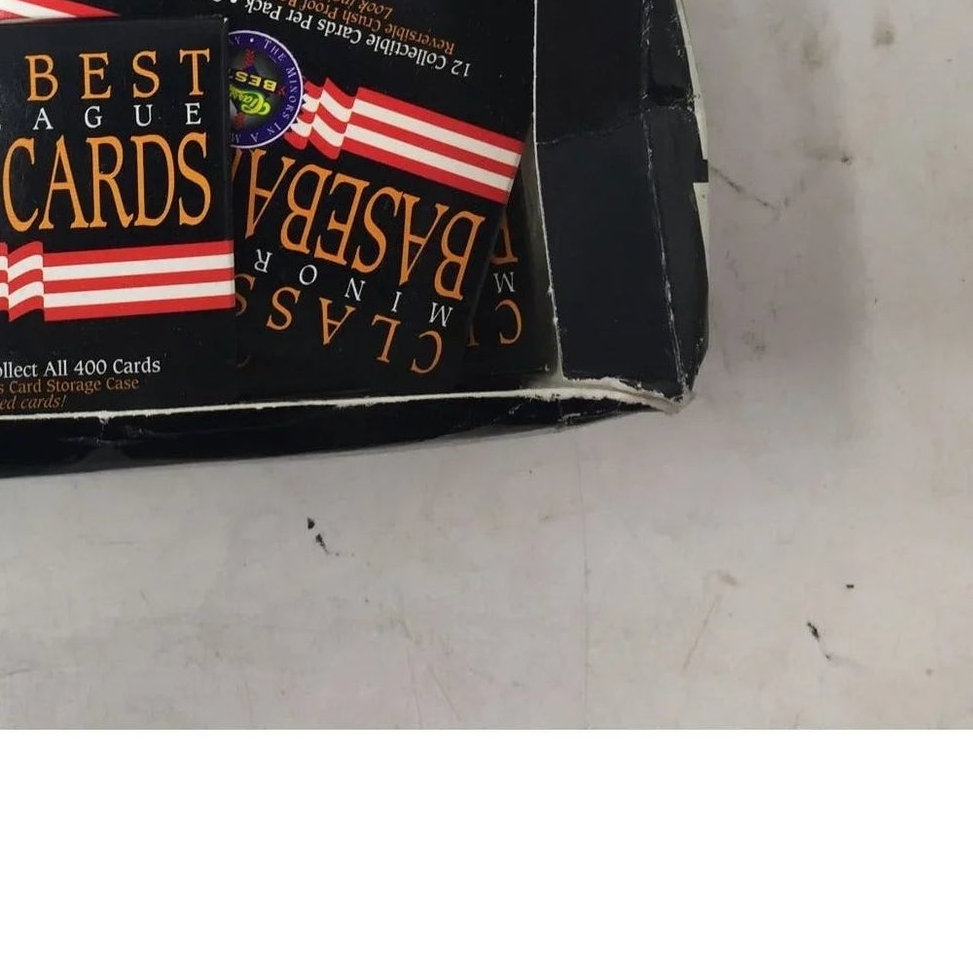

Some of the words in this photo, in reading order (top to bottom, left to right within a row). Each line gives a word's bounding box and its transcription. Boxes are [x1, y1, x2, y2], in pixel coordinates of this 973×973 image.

[285, 8, 313, 31] Per
[342, 9, 382, 28] Crush
[316, 18, 362, 45] Cards
[384, 22, 456, 56] Reversible
[365, 38, 447, 71] Collectible
[25, 48, 210, 102] BEST
[451, 58, 472, 78] 12
[234, 70, 277, 92] BES
[2, 132, 212, 232] CARDS
[231, 148, 485, 300] BASEBA
[253, 248, 453, 327] MINOR
[43, 359, 68, 377] All
[74, 359, 107, 376] 400
[112, 356, 161, 374] Cards
[9, 378, 42, 394] Card
[46, 378, 101, 394] Storage
[105, 377, 139, 391] Case
[20, 395, 67, 409] cards!
